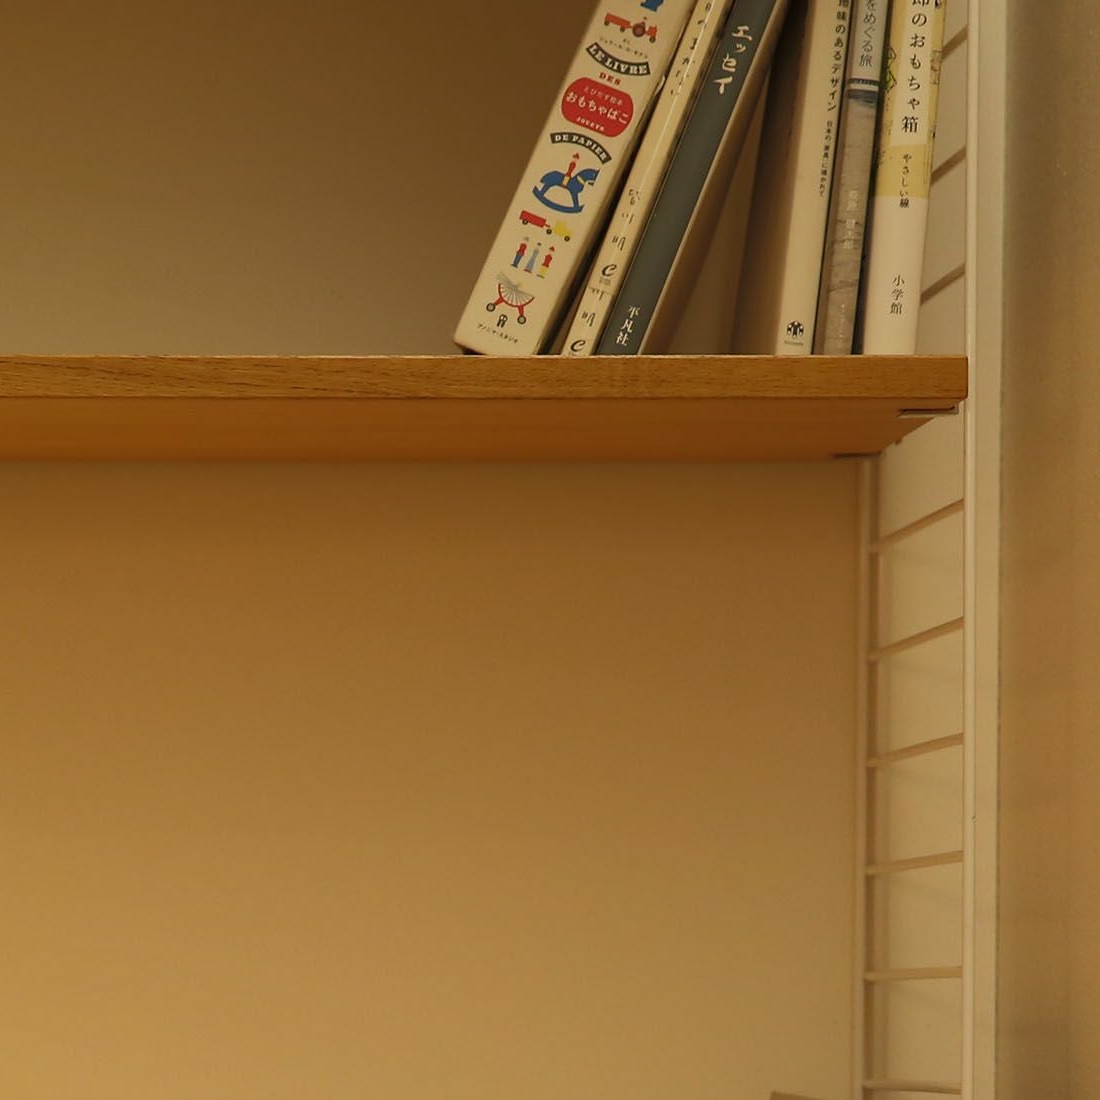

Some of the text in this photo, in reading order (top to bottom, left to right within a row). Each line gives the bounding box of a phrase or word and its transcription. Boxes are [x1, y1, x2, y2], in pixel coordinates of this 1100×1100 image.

[605, 56, 648, 75] LIVRE
[711, 25, 753, 95] エッセイ
[599, 72, 621, 86] DES
[566, 91, 629, 125] おもちゃばこ
[554, 133, 608, 161] DE PAPIER
[890, 275, 905, 315] 小学館
[616, 306, 641, 347] 平凡社
